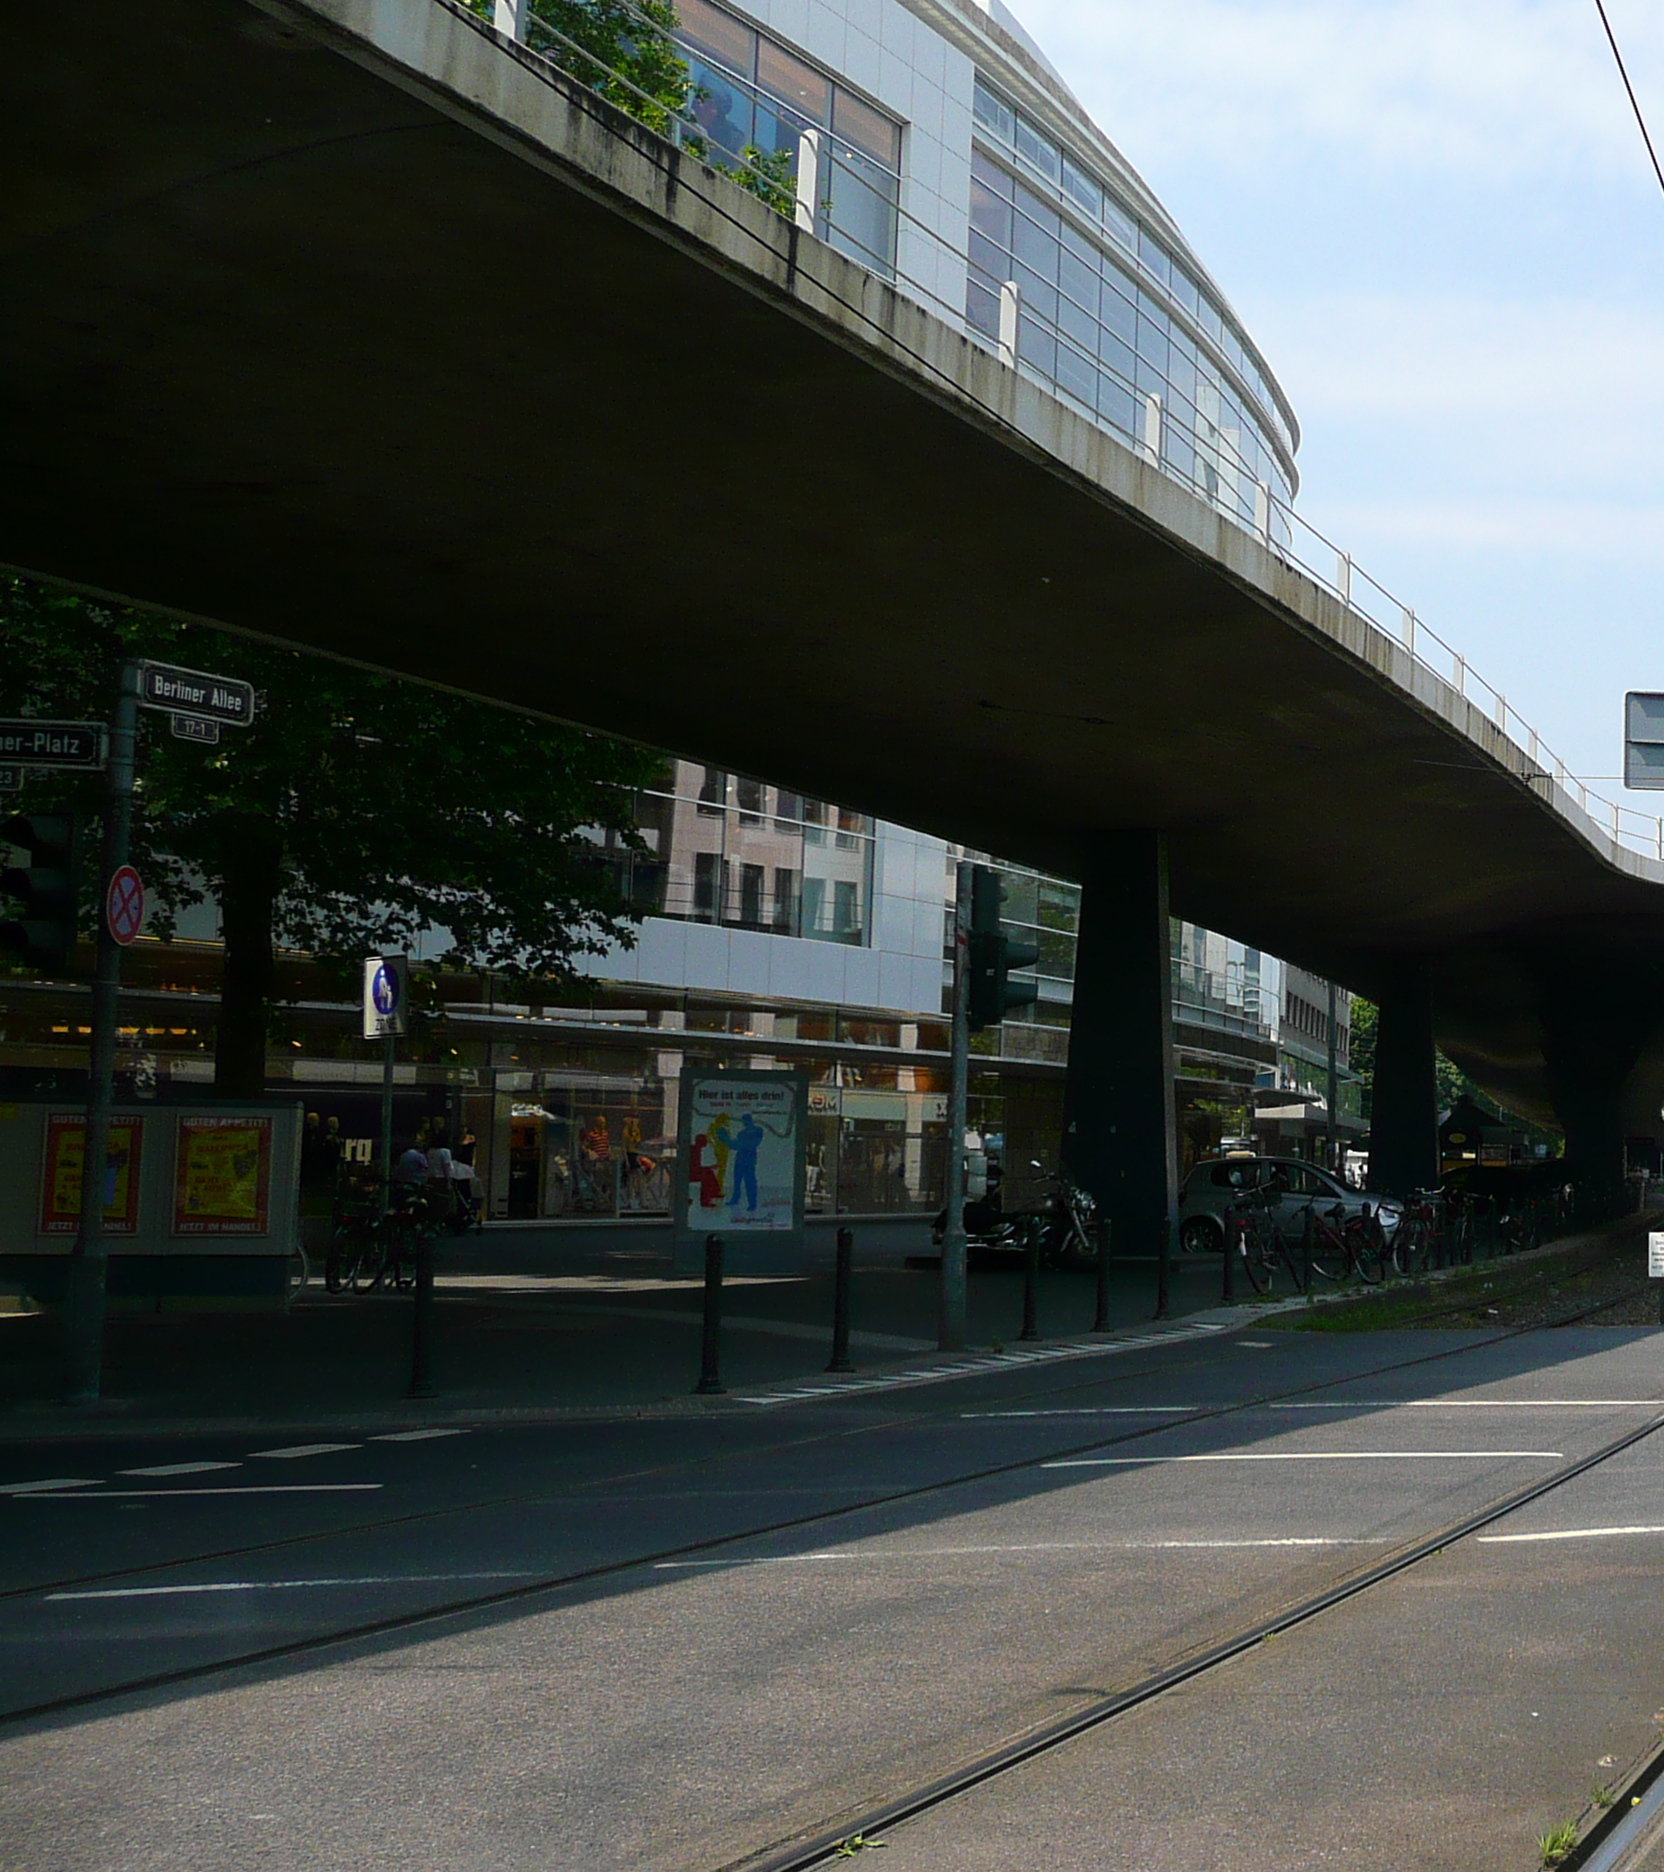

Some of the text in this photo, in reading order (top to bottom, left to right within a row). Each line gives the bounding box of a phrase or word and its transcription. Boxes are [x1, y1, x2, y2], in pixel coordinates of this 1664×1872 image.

[154, 675, 242, 711] Berliner Allee
[185, 720, 206, 736] 17-1
